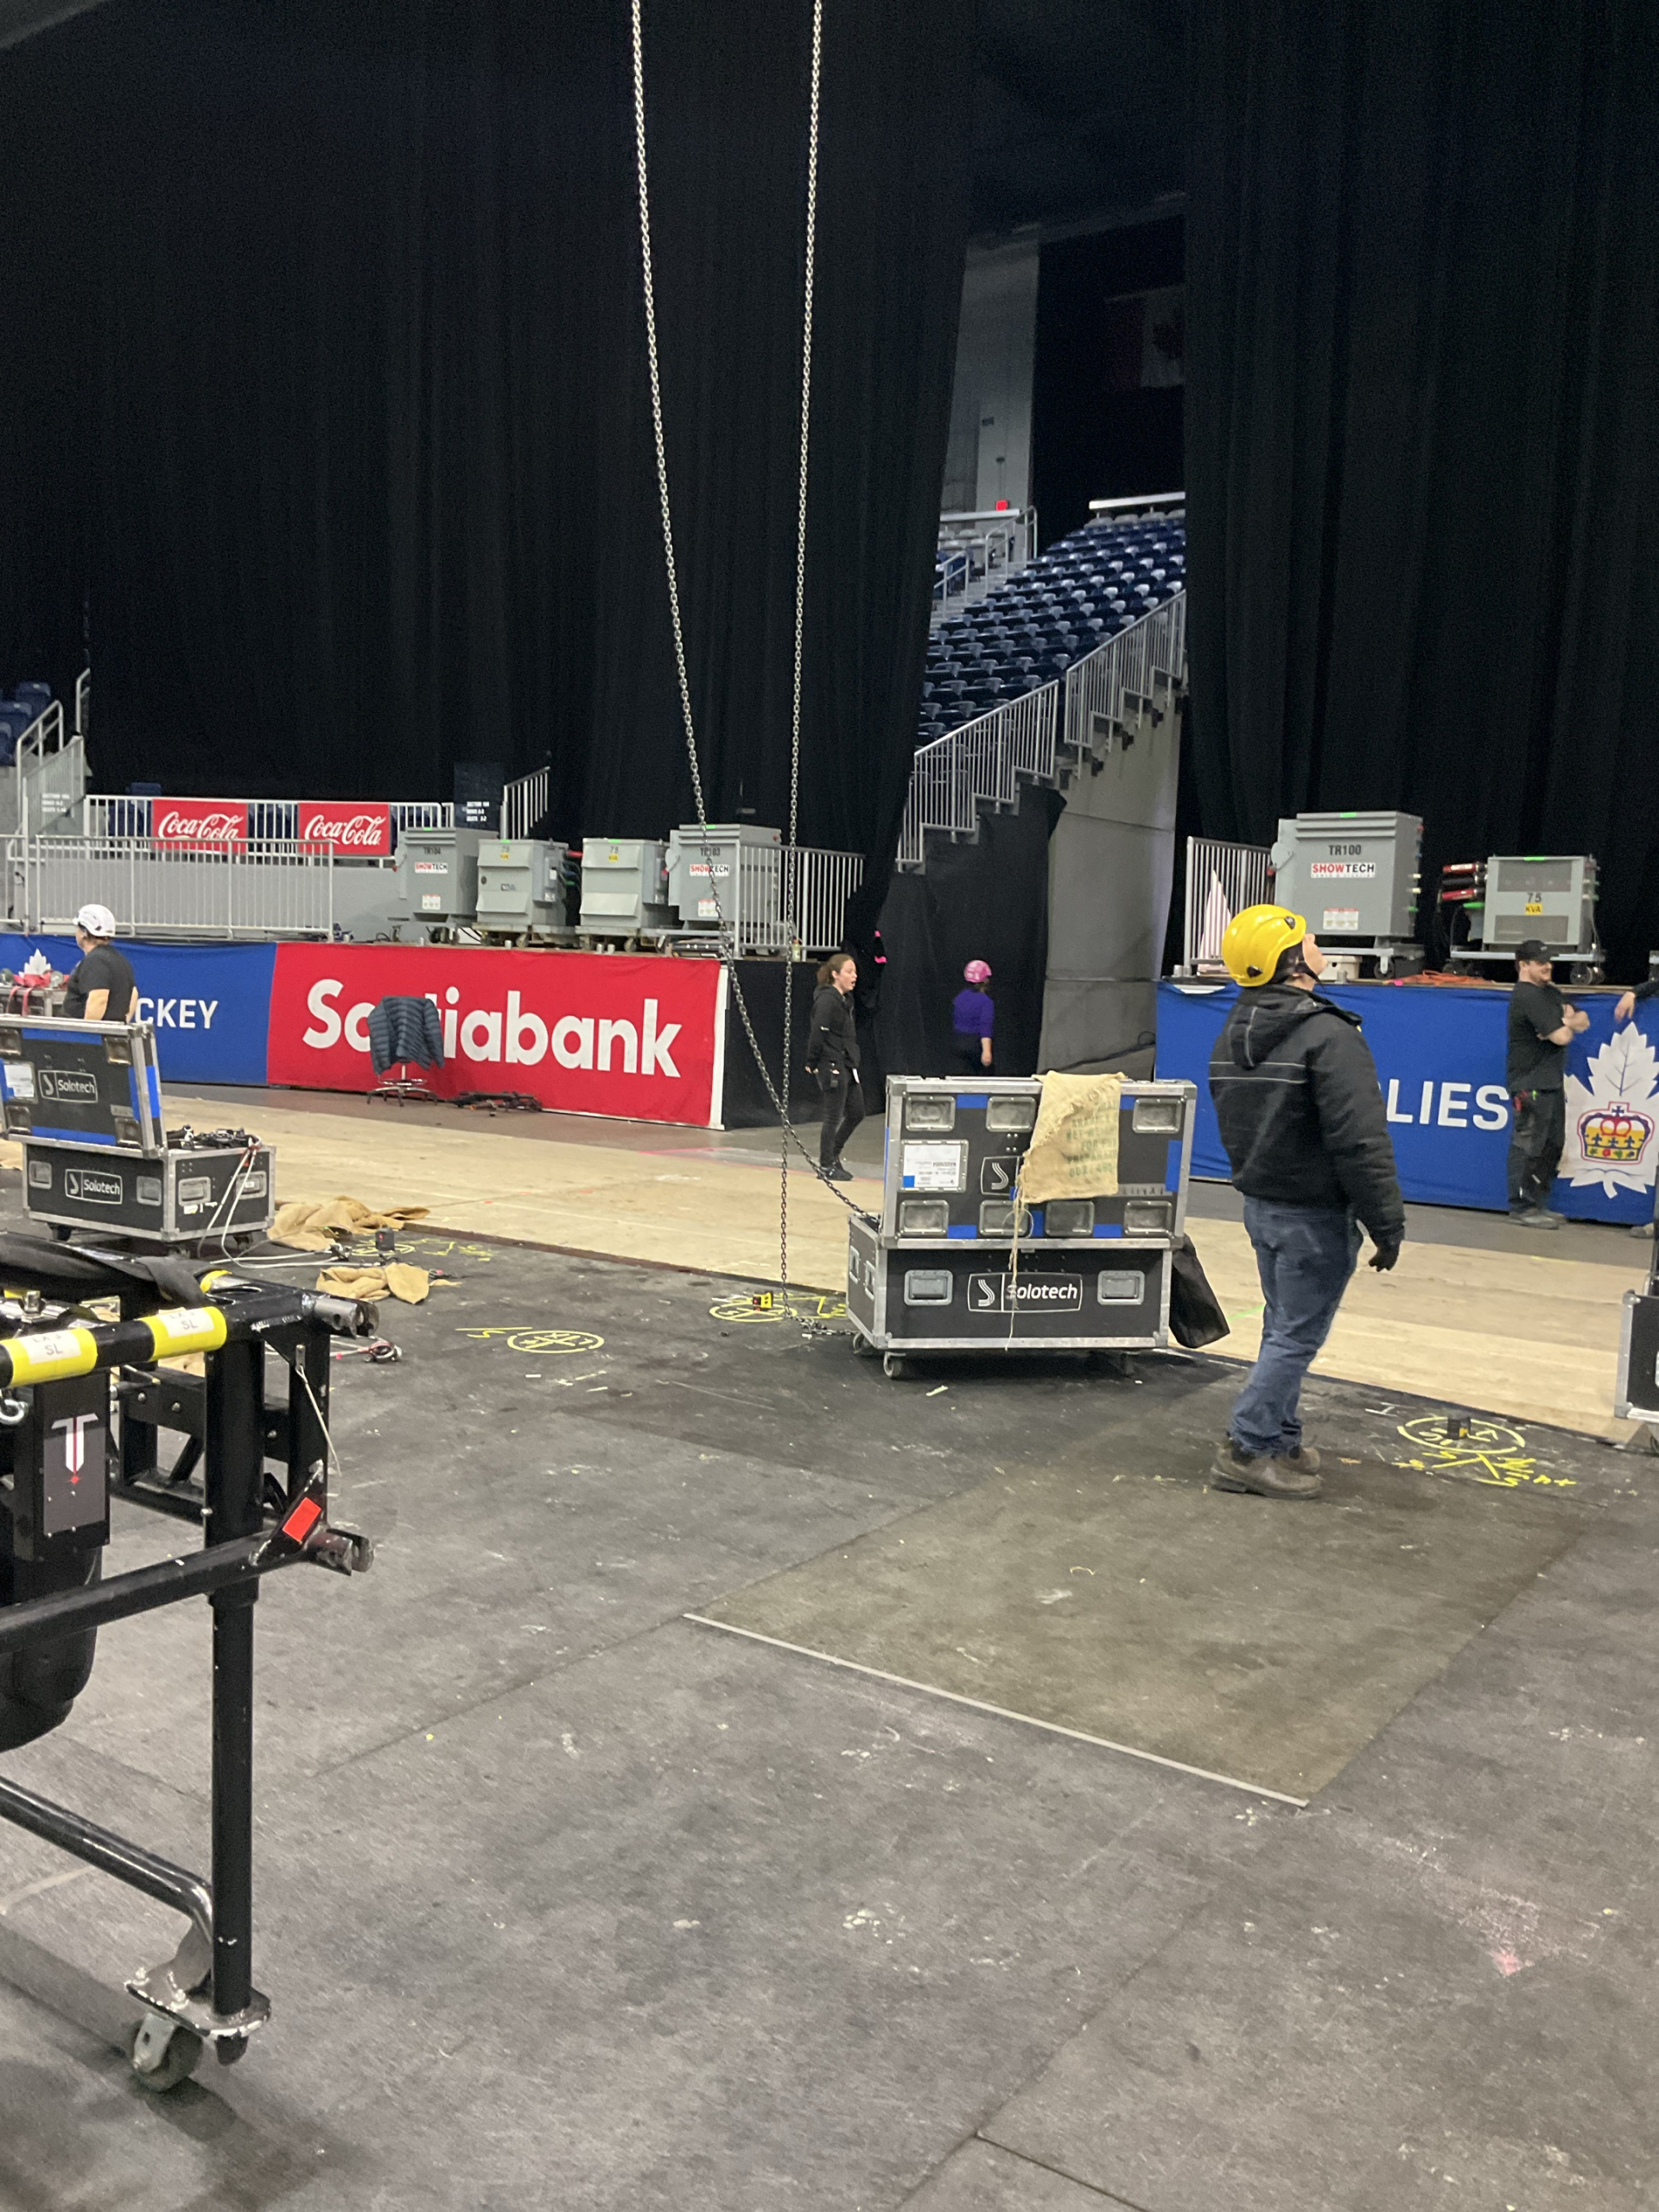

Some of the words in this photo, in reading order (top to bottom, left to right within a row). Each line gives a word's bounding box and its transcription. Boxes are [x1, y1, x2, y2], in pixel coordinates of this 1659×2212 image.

[304, 814, 386, 845] Coca-Cola
[1328, 844, 1362, 855] TR100
[1313, 863, 1375, 874] SHOWTECH
[1527, 893, 1542, 904] 75
[1525, 905, 1541, 913] KVA
[135, 997, 219, 1029] CKEY
[302, 978, 682, 1077] Sciabank
[58, 1079, 96, 1094] Solotech
[1386, 1078, 1510, 1131] LIES
[84, 1179, 121, 1196] Solotech
[181, 1319, 199, 1331] SL
[44, 1344, 63, 1356] SL
